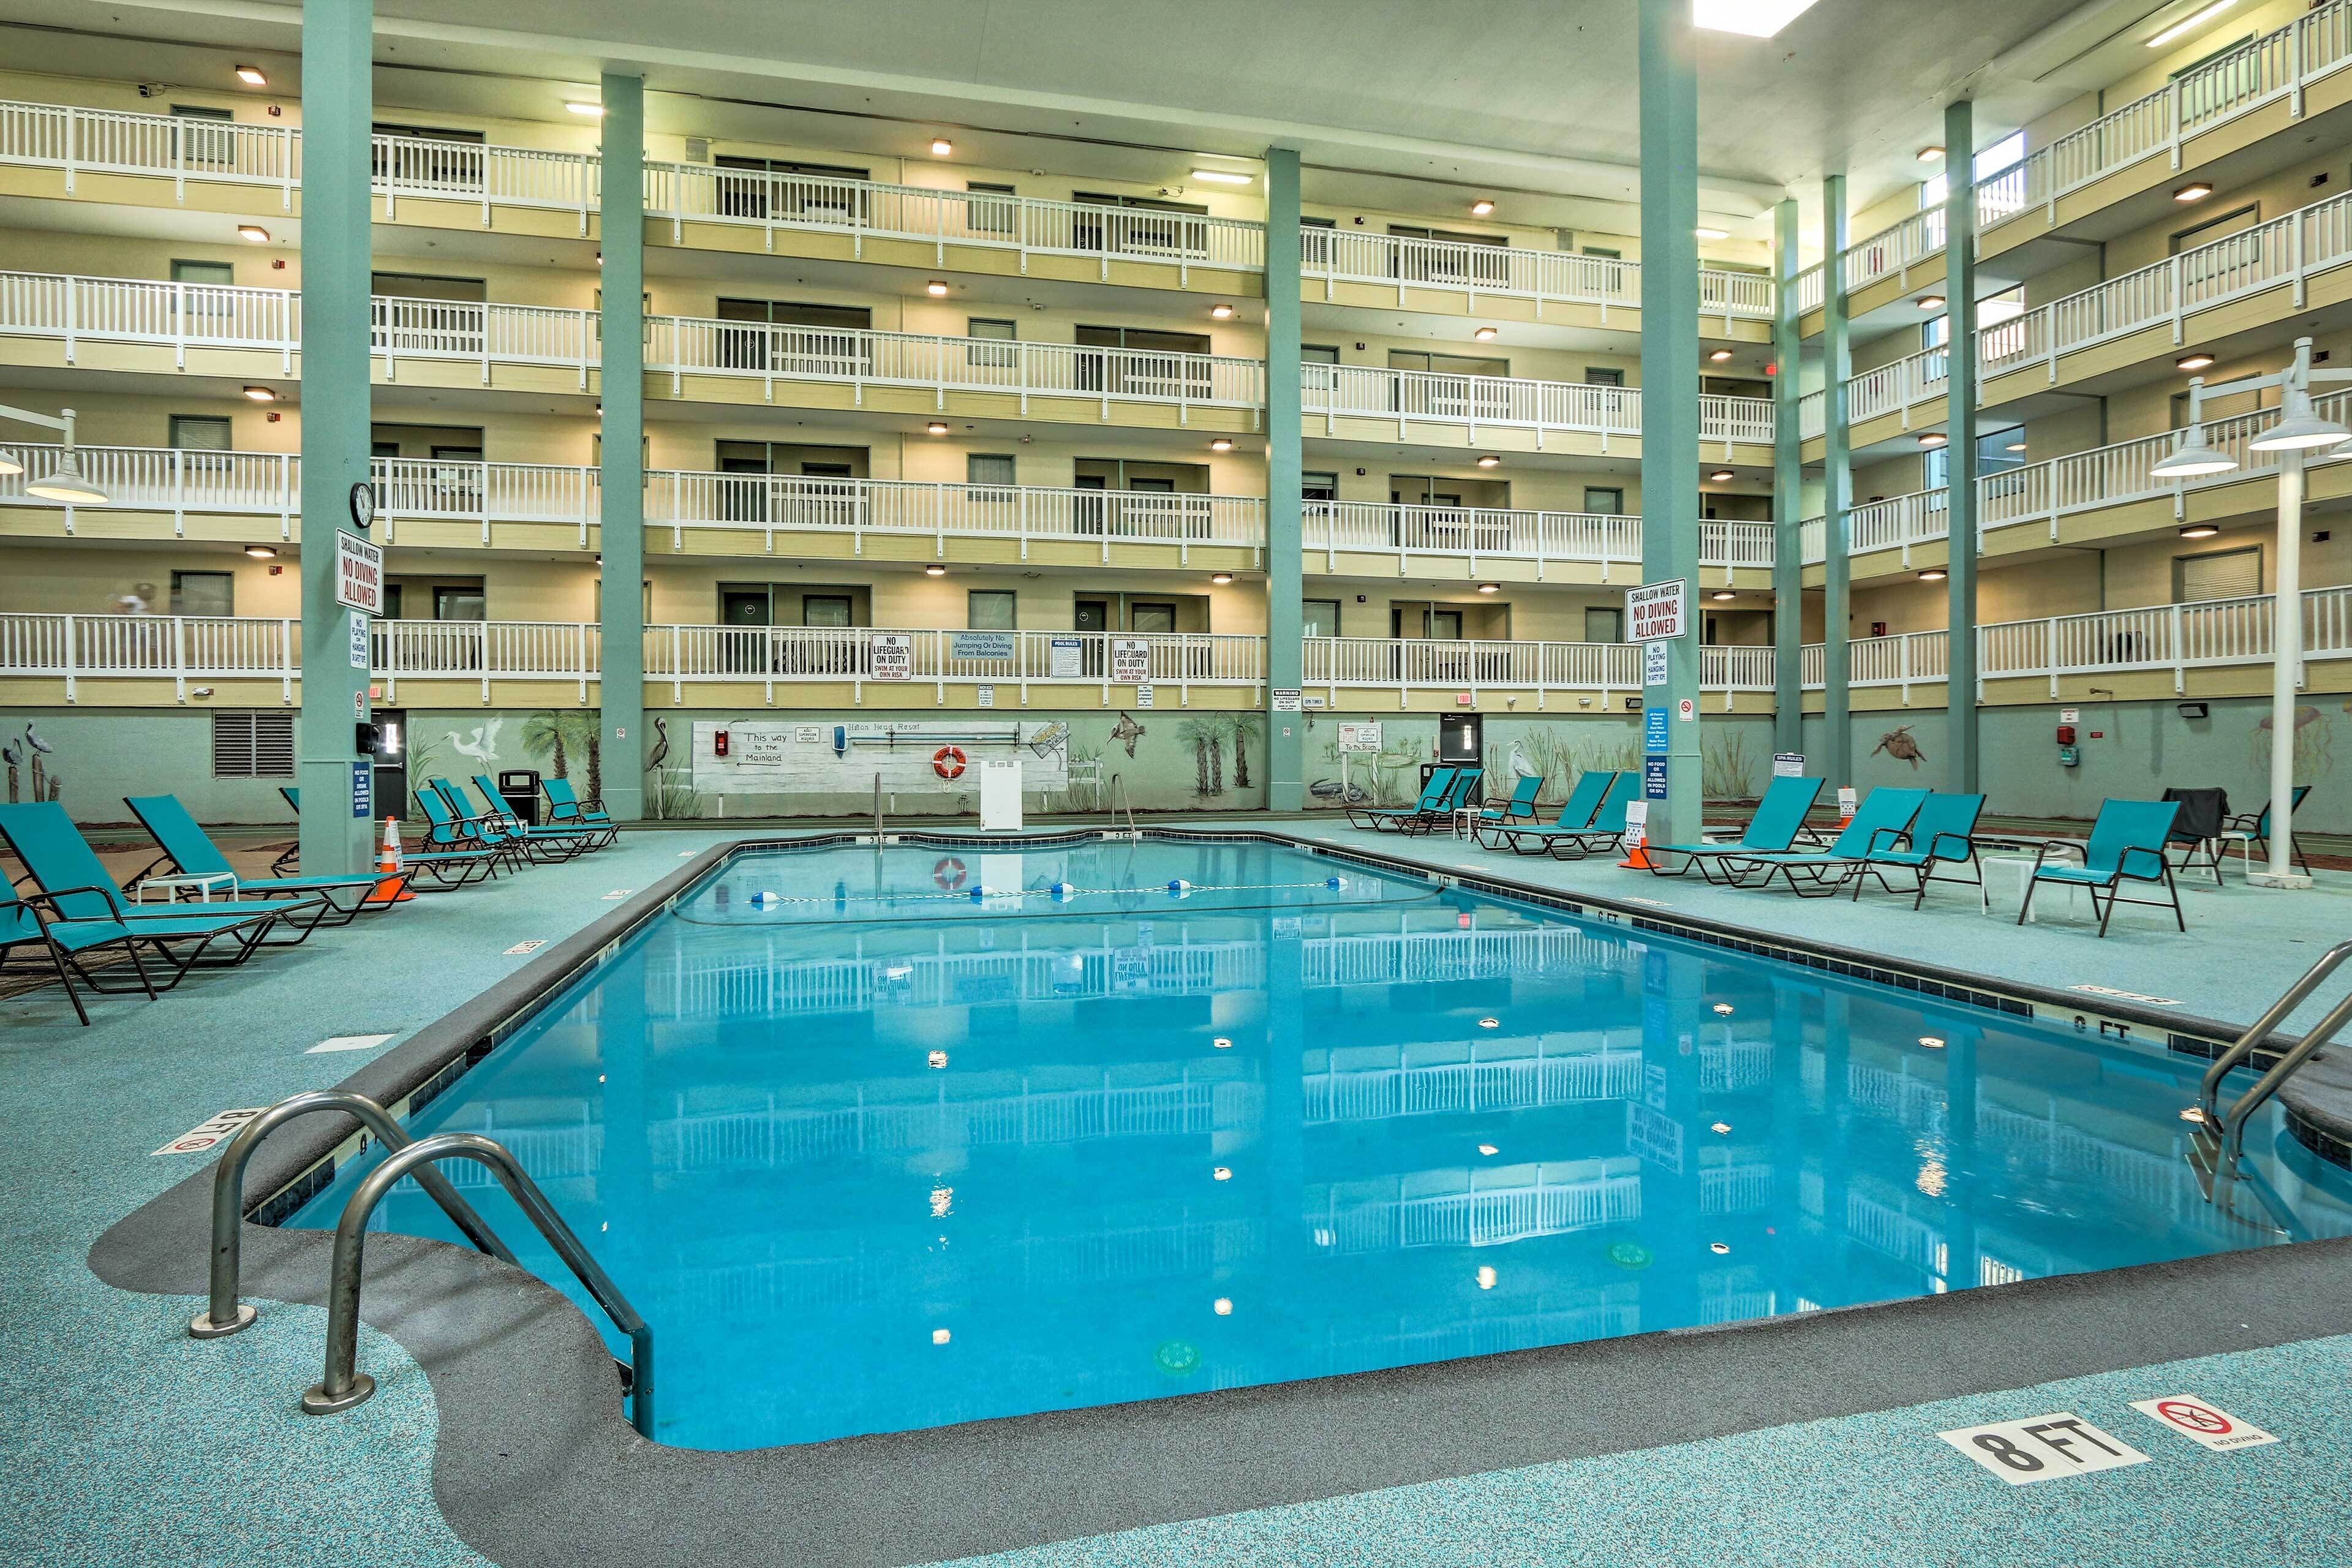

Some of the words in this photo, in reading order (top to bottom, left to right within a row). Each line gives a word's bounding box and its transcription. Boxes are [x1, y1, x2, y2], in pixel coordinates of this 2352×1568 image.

[341, 536, 363, 554] SHALLOW
[364, 546, 379, 564] WATER
[343, 556, 353, 577] NO
[355, 560, 377, 586] DIVING
[344, 579, 376, 607] ALLOWED
[1632, 589, 1659, 603] SHALLOW
[1660, 584, 1679, 597] WATER
[1634, 605, 1645, 621] NO
[1648, 600, 1677, 619] DIVING
[356, 619, 362, 627] NO
[1635, 618, 1676, 638] ALLOWED
[352, 627, 366, 638] PLAYING
[352, 643, 366, 652] HANGING
[744, 733, 767, 742] This
[220, 1111, 258, 1120] 8
[192, 1121, 243, 1135] FT
[1972, 1434, 2045, 1472] 8
[2021, 1419, 2122, 1463] FT
[2228, 1434, 2263, 1444] DIVING
